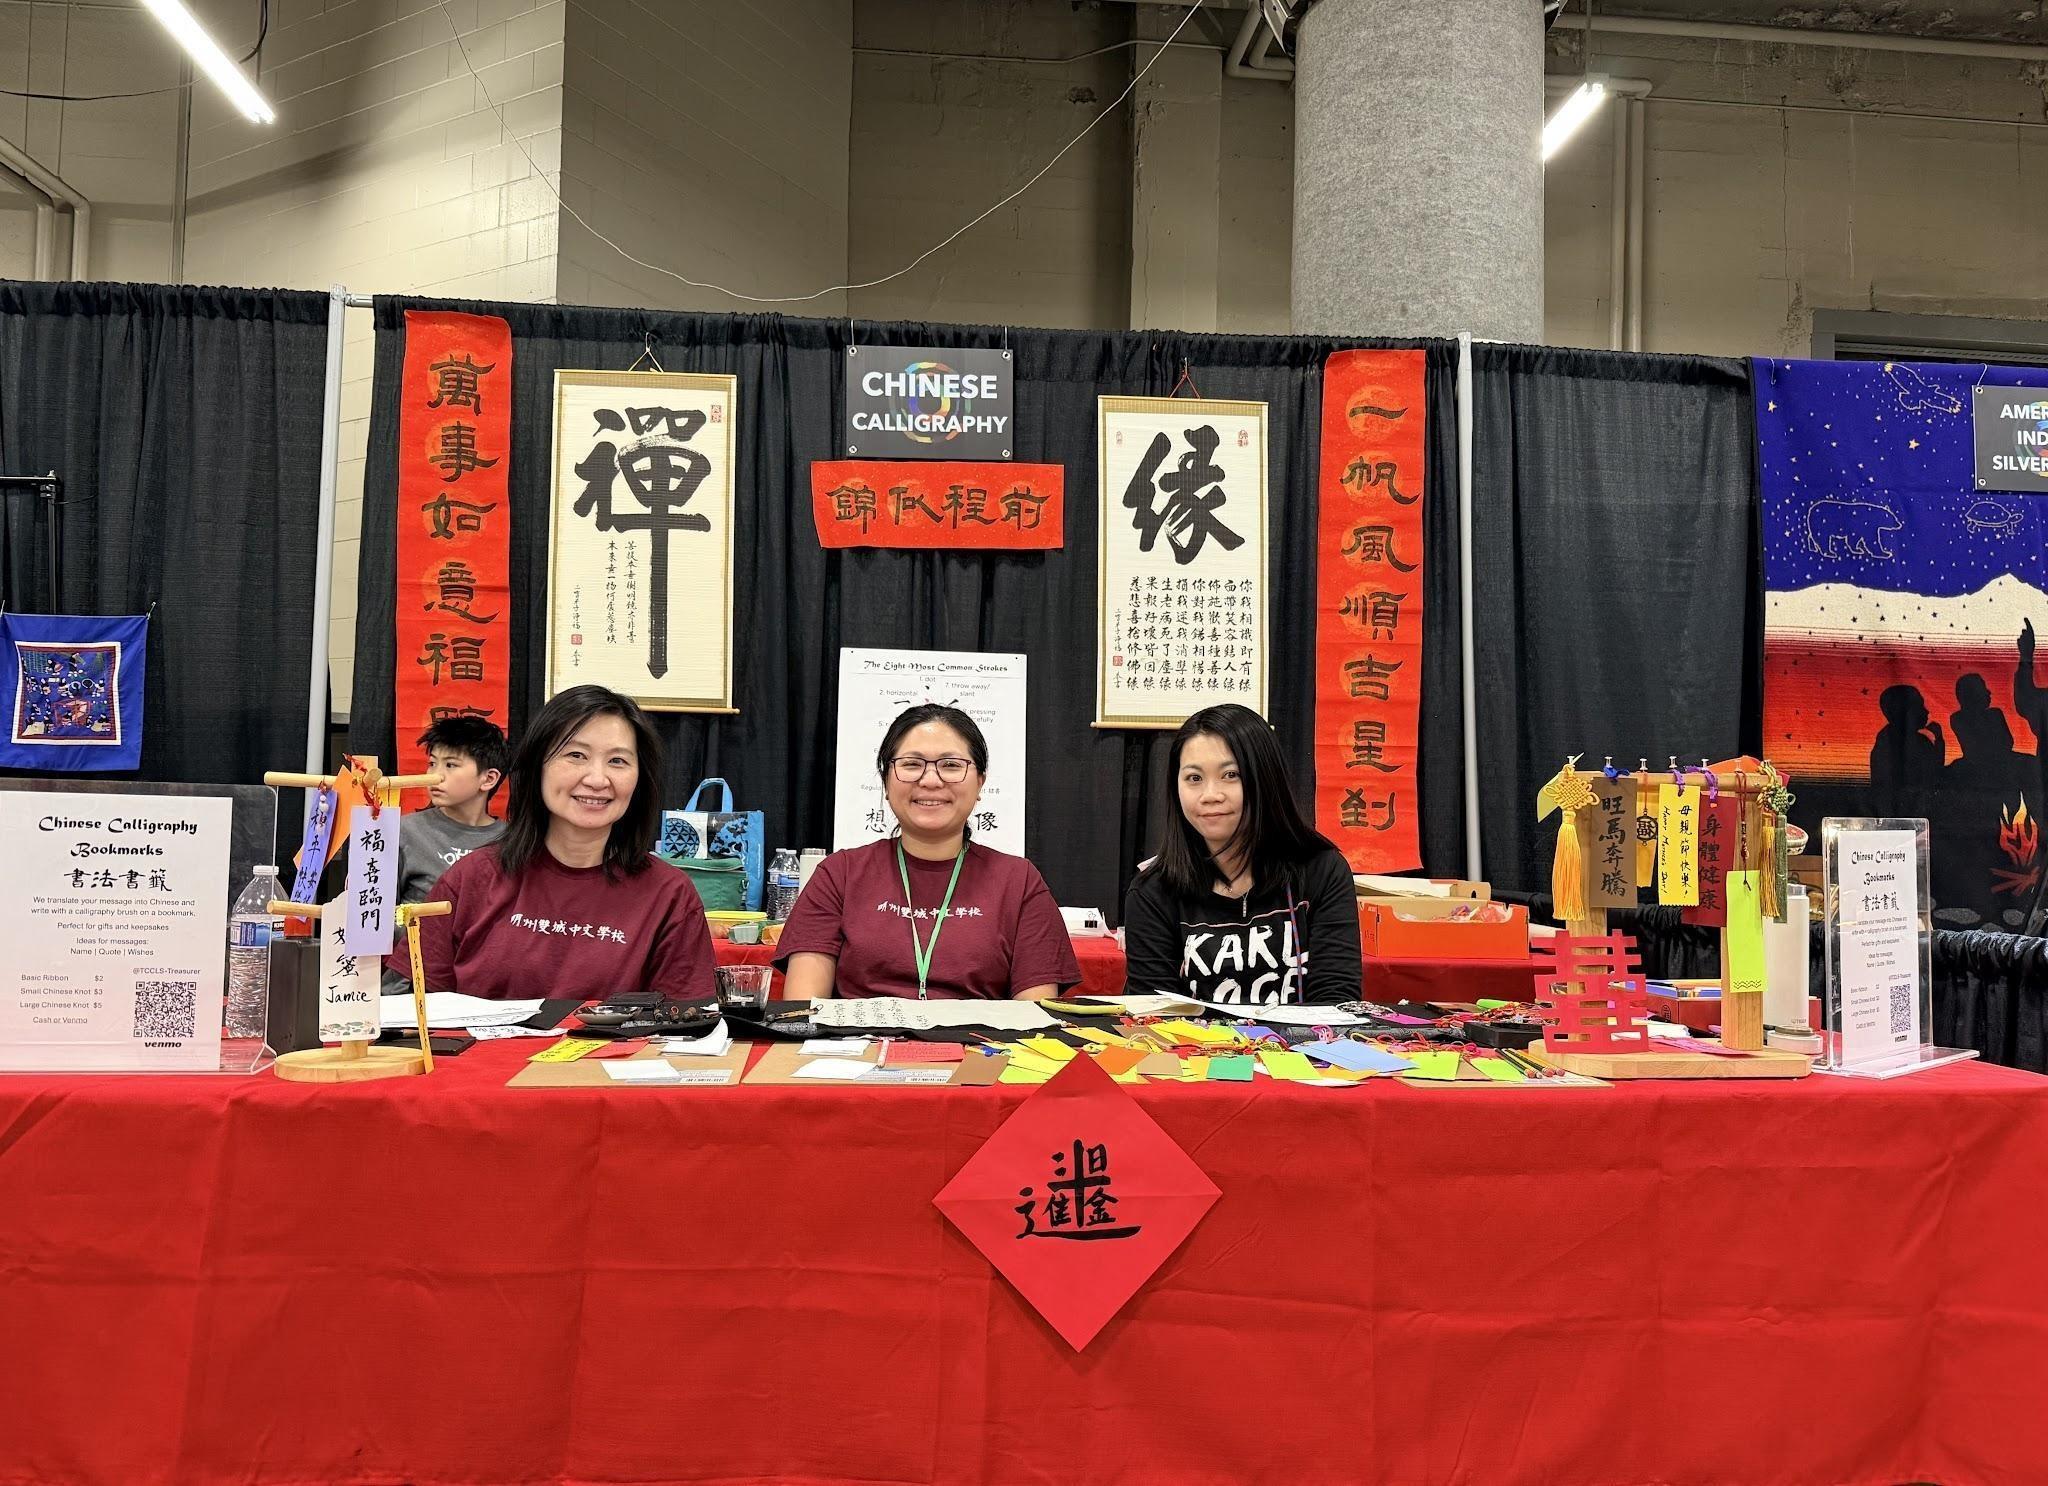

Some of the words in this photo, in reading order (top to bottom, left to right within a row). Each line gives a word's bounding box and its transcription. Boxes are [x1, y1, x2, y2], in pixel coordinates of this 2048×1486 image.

[862, 371, 998, 399] CHINESE
[852, 412, 1008, 433] CALLIGRAPHY
[417, 353, 500, 720] 萬事如意福
[864, 660, 880, 669] The
[884, 662, 906, 670] Eight
[908, 662, 935, 672] Most
[938, 663, 972, 672] Common
[975, 664, 1008, 672] Strokes
[39, 816, 101, 831] Chinese
[108, 818, 198, 834] Calligraphy
[866, 808, 886, 833] 想
[975, 812, 998, 831] 像
[71, 843, 163, 857] Bookmarks
[1184, 920, 1309, 977] KARL
[326, 985, 373, 1003] Jamie
